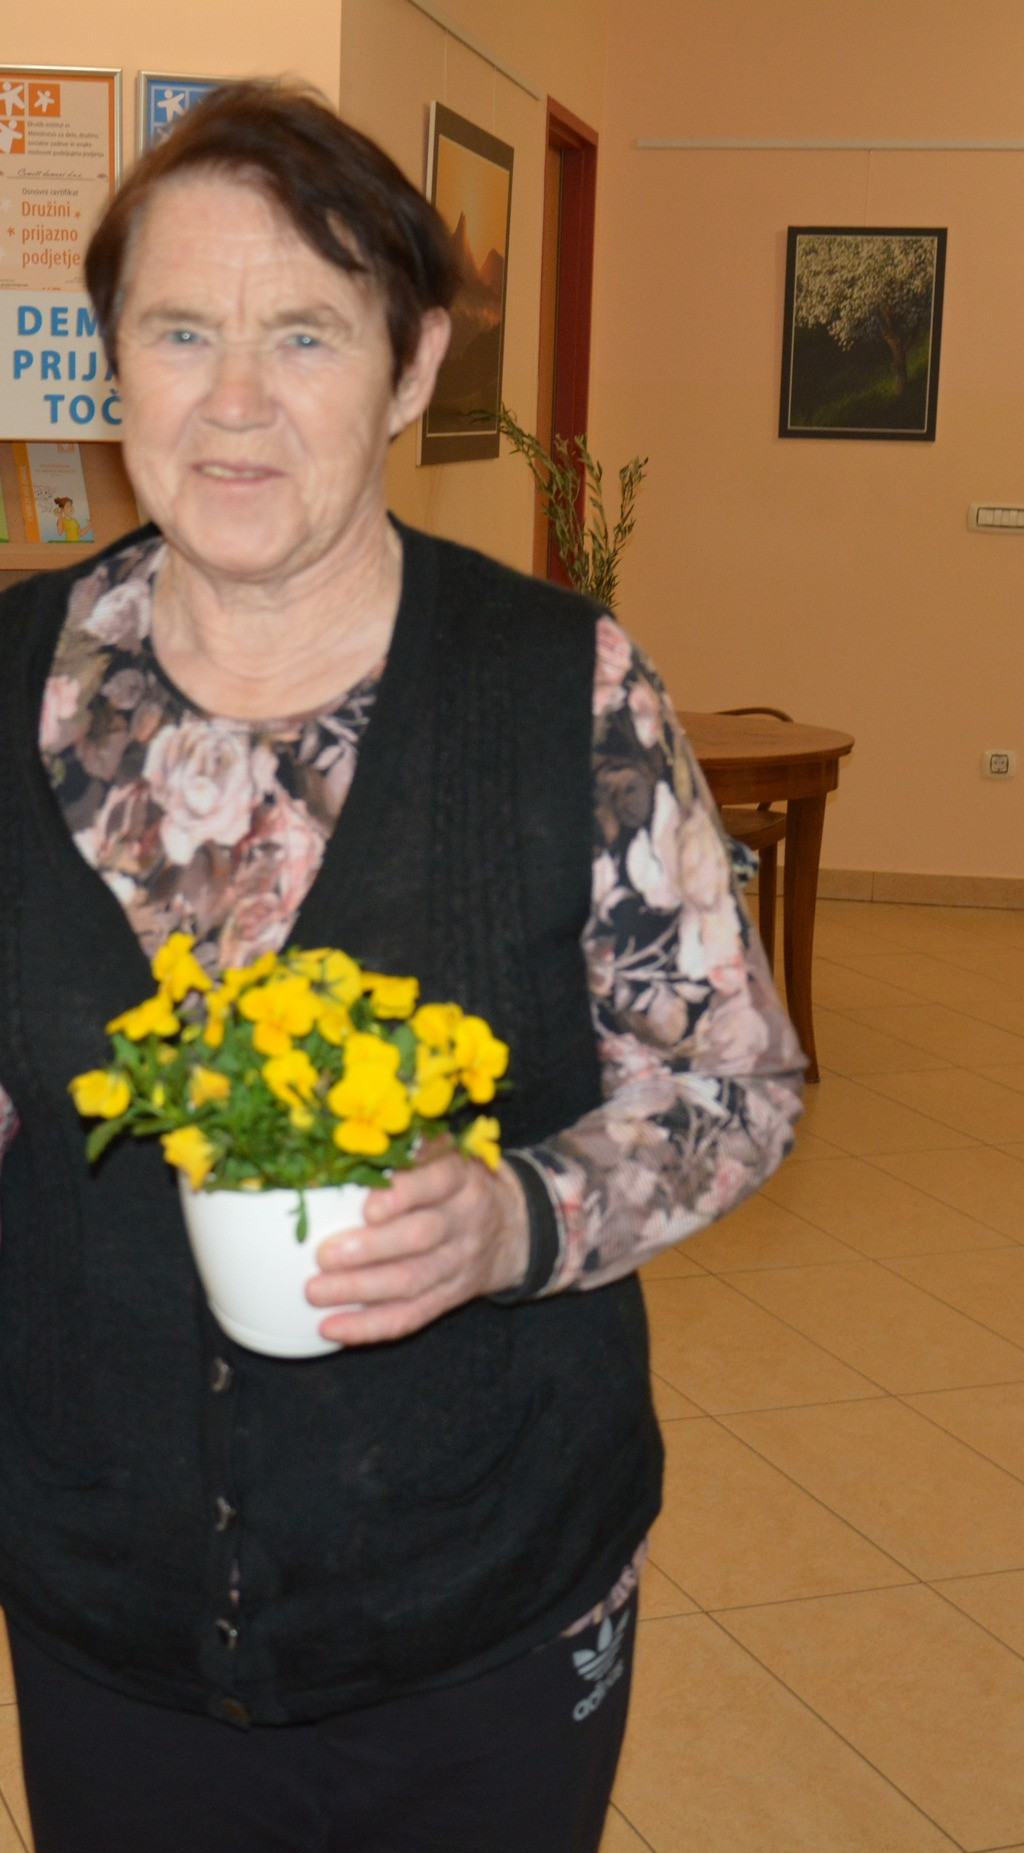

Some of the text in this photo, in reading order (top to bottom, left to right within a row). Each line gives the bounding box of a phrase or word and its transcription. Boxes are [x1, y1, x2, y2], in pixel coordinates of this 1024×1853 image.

[21, 187, 79, 197] Osnovni certifikat
[21, 200, 71, 218] Družini
[21, 224, 78, 246] prijazno
[22, 248, 81, 269] podjetje
